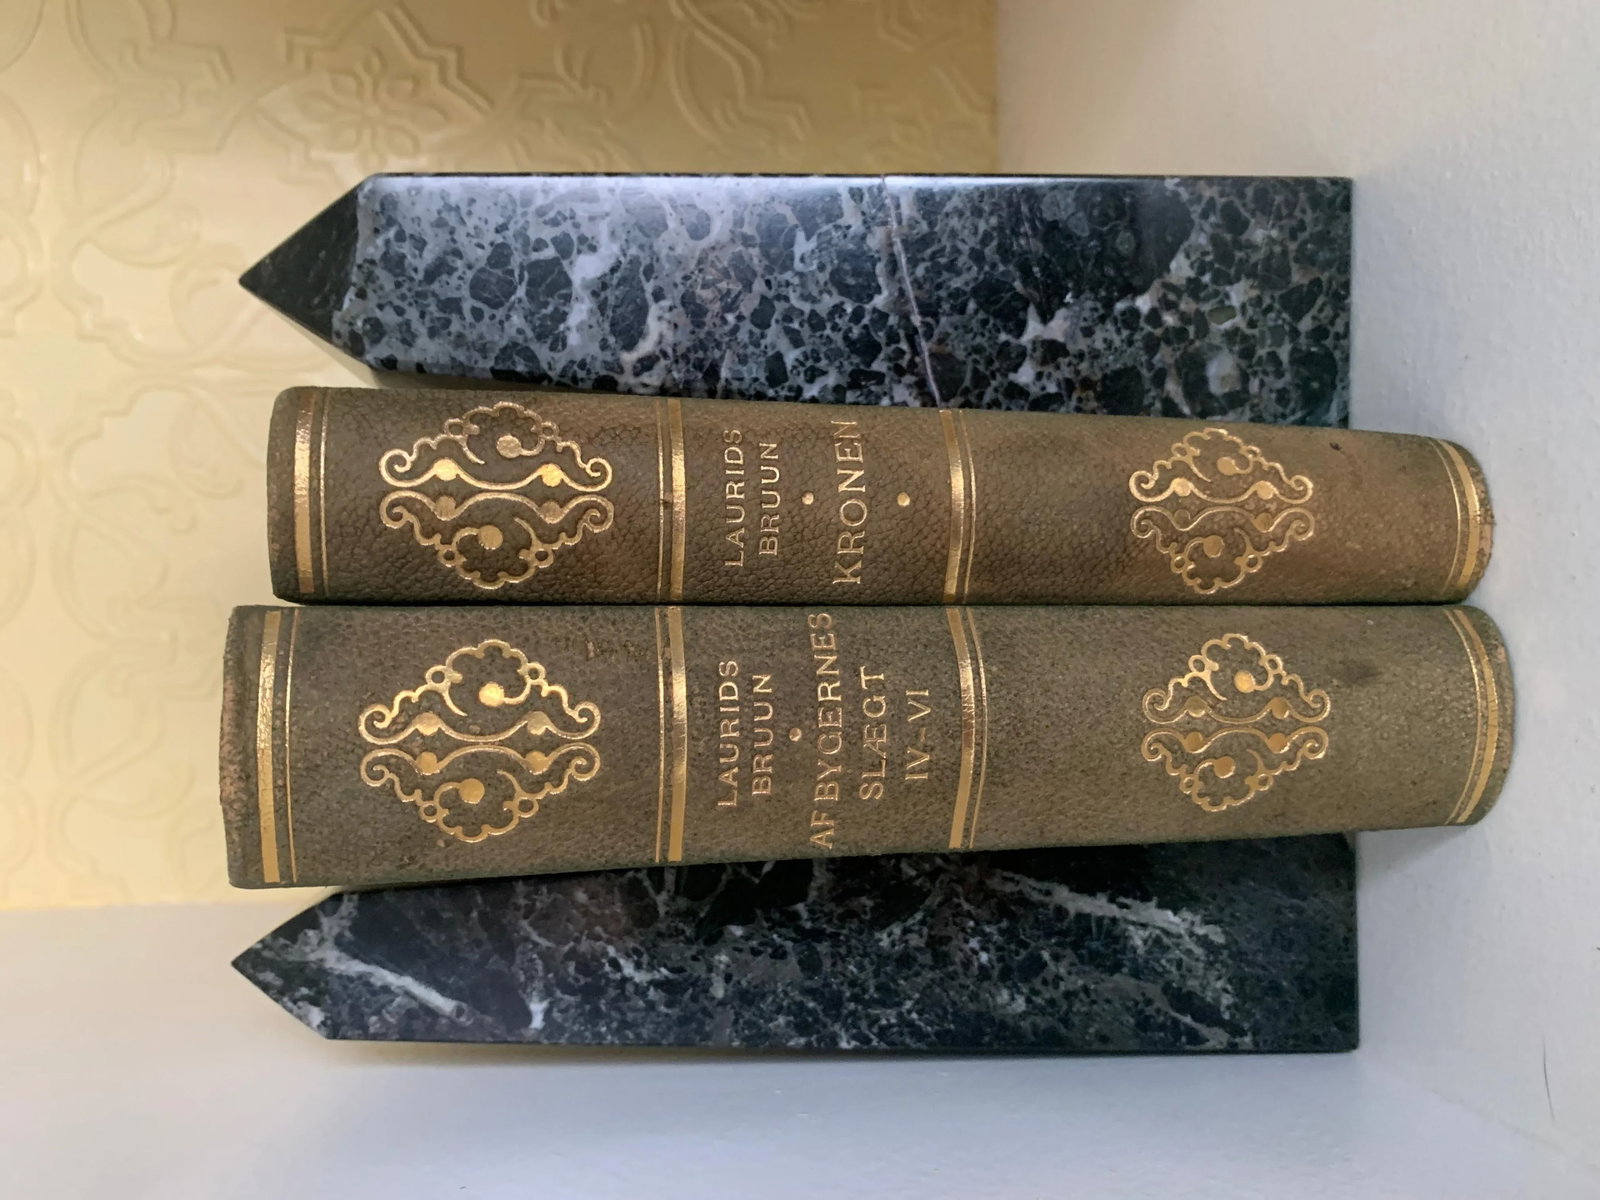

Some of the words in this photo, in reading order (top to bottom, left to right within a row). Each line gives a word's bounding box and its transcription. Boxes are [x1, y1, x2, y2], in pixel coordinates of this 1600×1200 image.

[722, 429, 745, 567] LAURIDS
[758, 442, 781, 556] BRUUN
[831, 420, 868, 584] KRONEN
[717, 660, 740, 807] LAURIDS
[751, 673, 774, 796] BRUUN
[808, 613, 843, 802] BYGERNES
[859, 665, 887, 800] SLÆGT
[809, 810, 836, 849] AF
